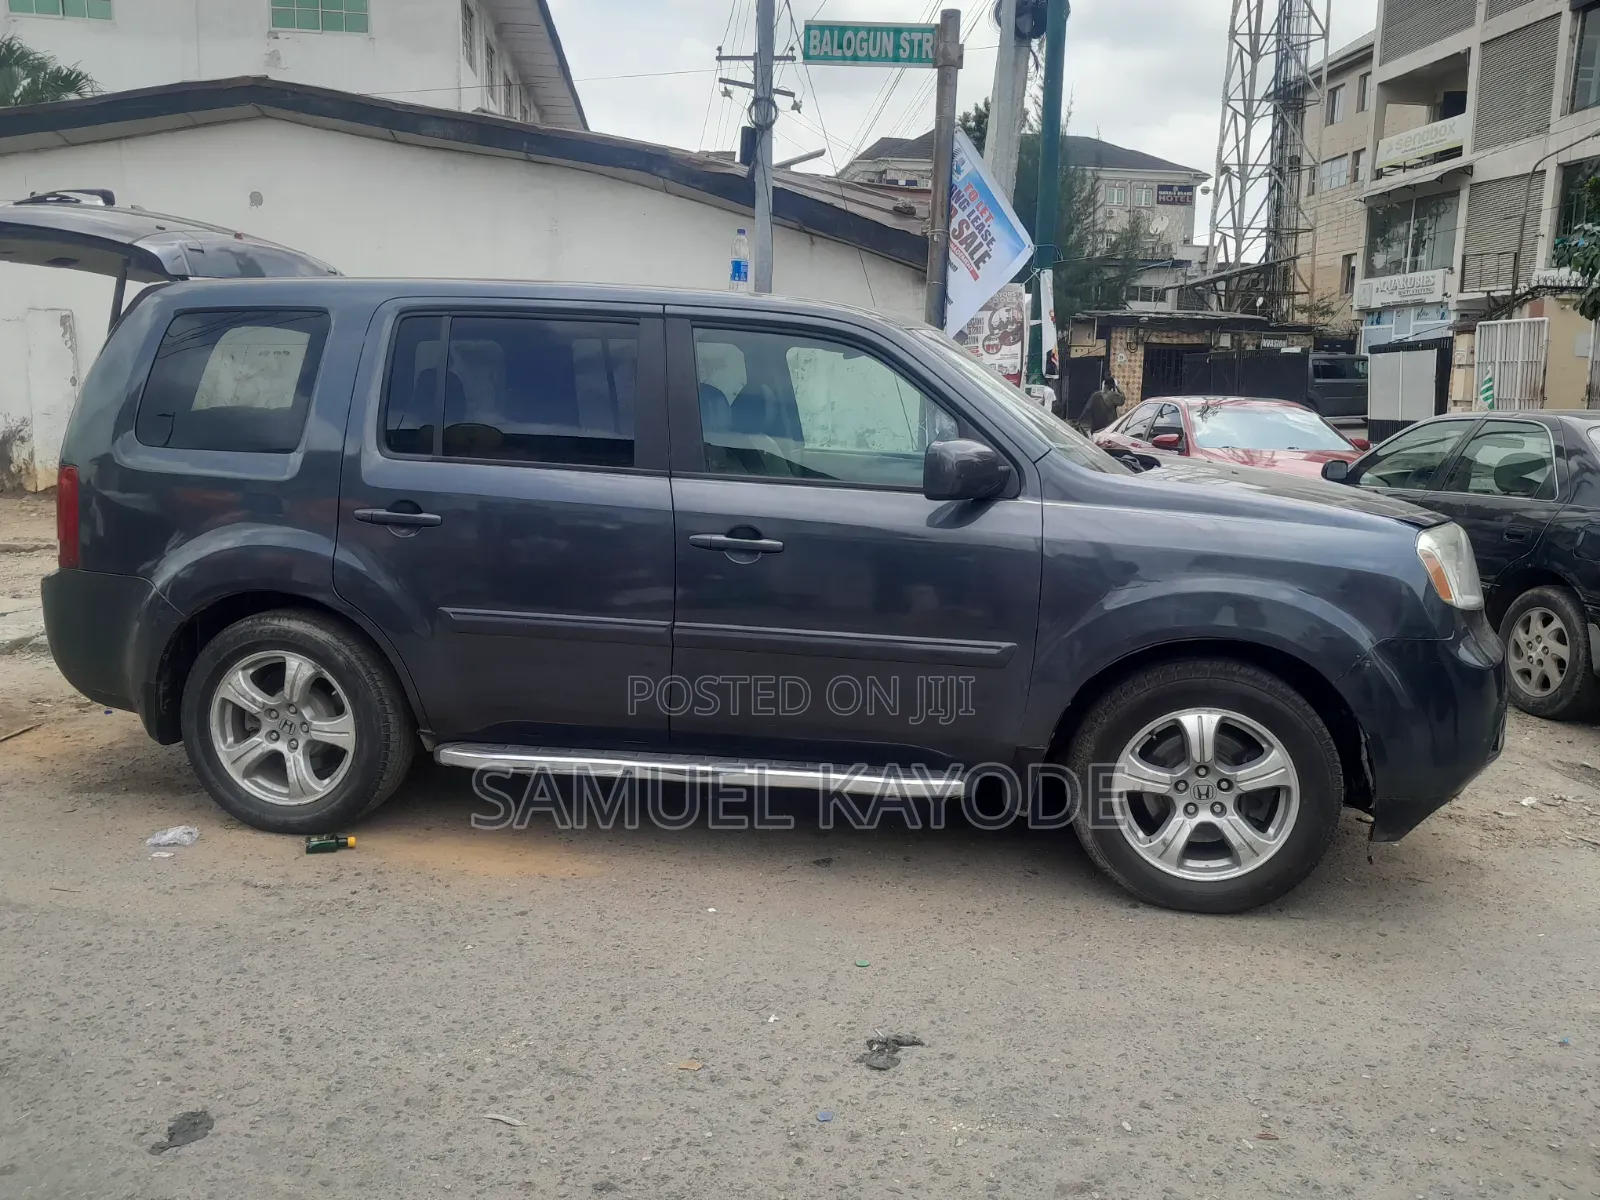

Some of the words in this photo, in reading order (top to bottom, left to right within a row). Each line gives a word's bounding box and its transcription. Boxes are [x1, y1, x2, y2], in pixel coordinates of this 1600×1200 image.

[808, 29, 895, 58] BALOGUN
[898, 31, 934, 59] STR
[949, 182, 971, 213] ONG
[963, 180, 980, 204] TO
[1158, 194, 1192, 203] HOTEL
[951, 218, 993, 272] SALE
